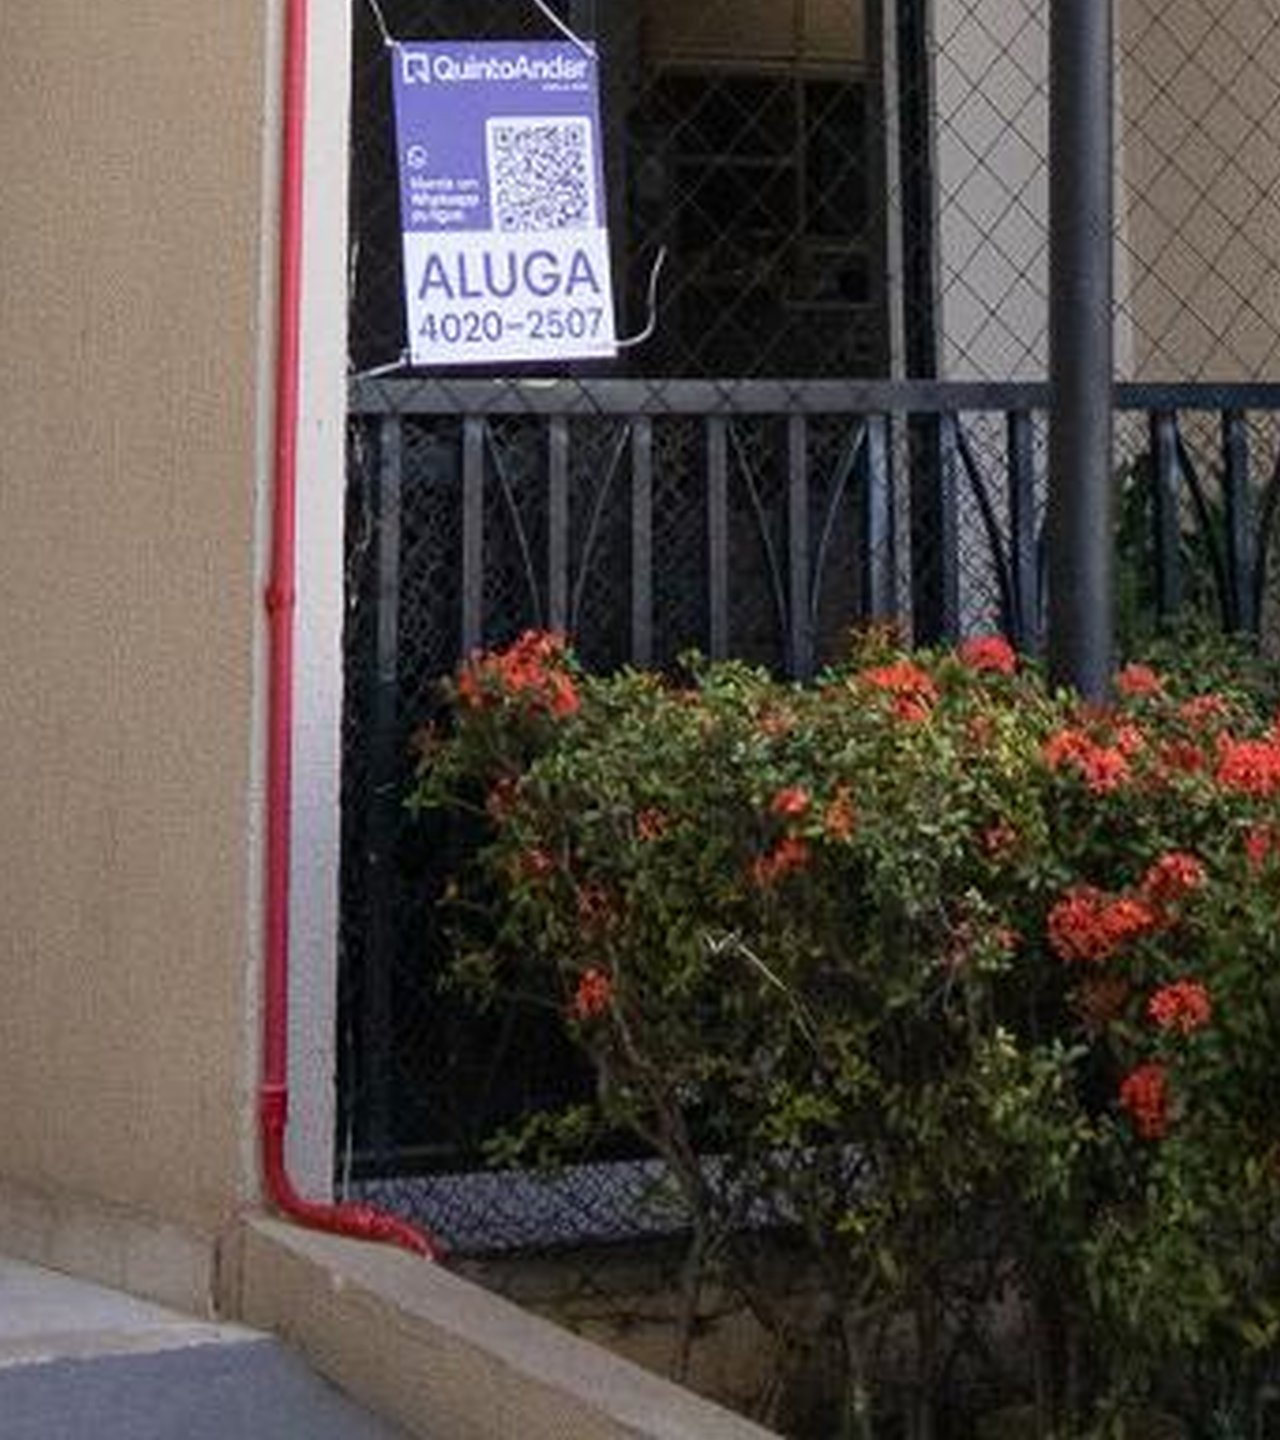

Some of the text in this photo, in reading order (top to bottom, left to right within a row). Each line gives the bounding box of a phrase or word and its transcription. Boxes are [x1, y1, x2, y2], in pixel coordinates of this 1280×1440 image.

[433, 54, 588, 81] QuintoAndar
[418, 248, 600, 300] ALUGA
[419, 307, 603, 342] 4020-2507
